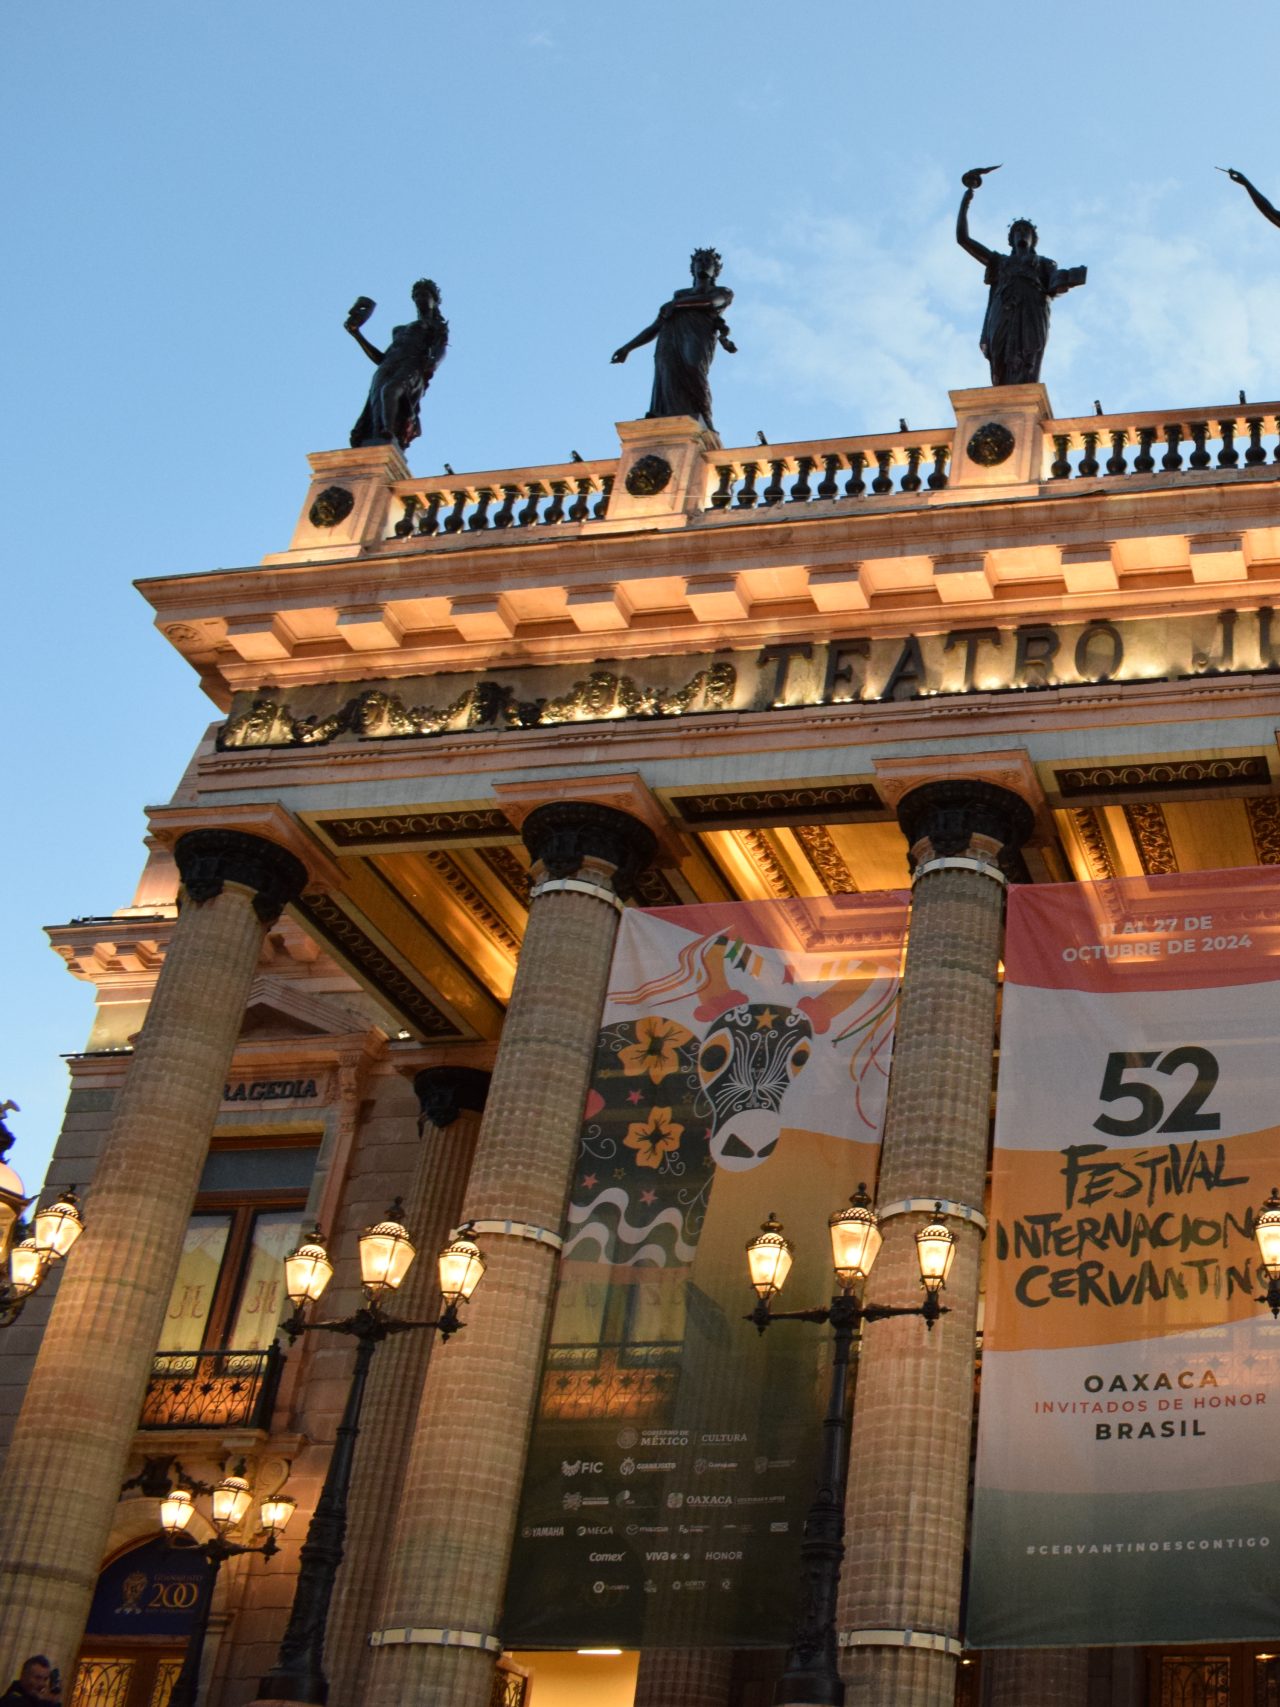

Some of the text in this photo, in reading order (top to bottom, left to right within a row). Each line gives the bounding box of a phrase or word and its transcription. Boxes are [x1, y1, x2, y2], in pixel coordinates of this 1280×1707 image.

[759, 622, 1124, 705] TEATRO
[1122, 920, 1147, 935] AL
[1154, 917, 1179, 933] 27
[1183, 915, 1213, 931] DE
[1062, 934, 1253, 962] OCTUBRE DE 2024
[1092, 1045, 1221, 1137] 52
[1060, 1140, 1250, 1210] FESTIVAL
[1084, 1369, 1219, 1394] OAXACA
[1034, 1392, 1268, 1414] INVITADOS DE HONOR
[701, 1433, 748, 1442] CULTURA
[1095, 1419, 1207, 1441] BRASIL
[641, 1435, 689, 1447] MÉXICO
[581, 1461, 604, 1474] FIC
[686, 1496, 733, 1505] OAXACA
[532, 1526, 565, 1537] YAMAHA
[705, 1551, 743, 1561] HONOR
[1027, 1536, 1272, 1556] #CERVANTINOESCONTIGO
[589, 1552, 626, 1563] Comex
[148, 1583, 199, 1608] 200
